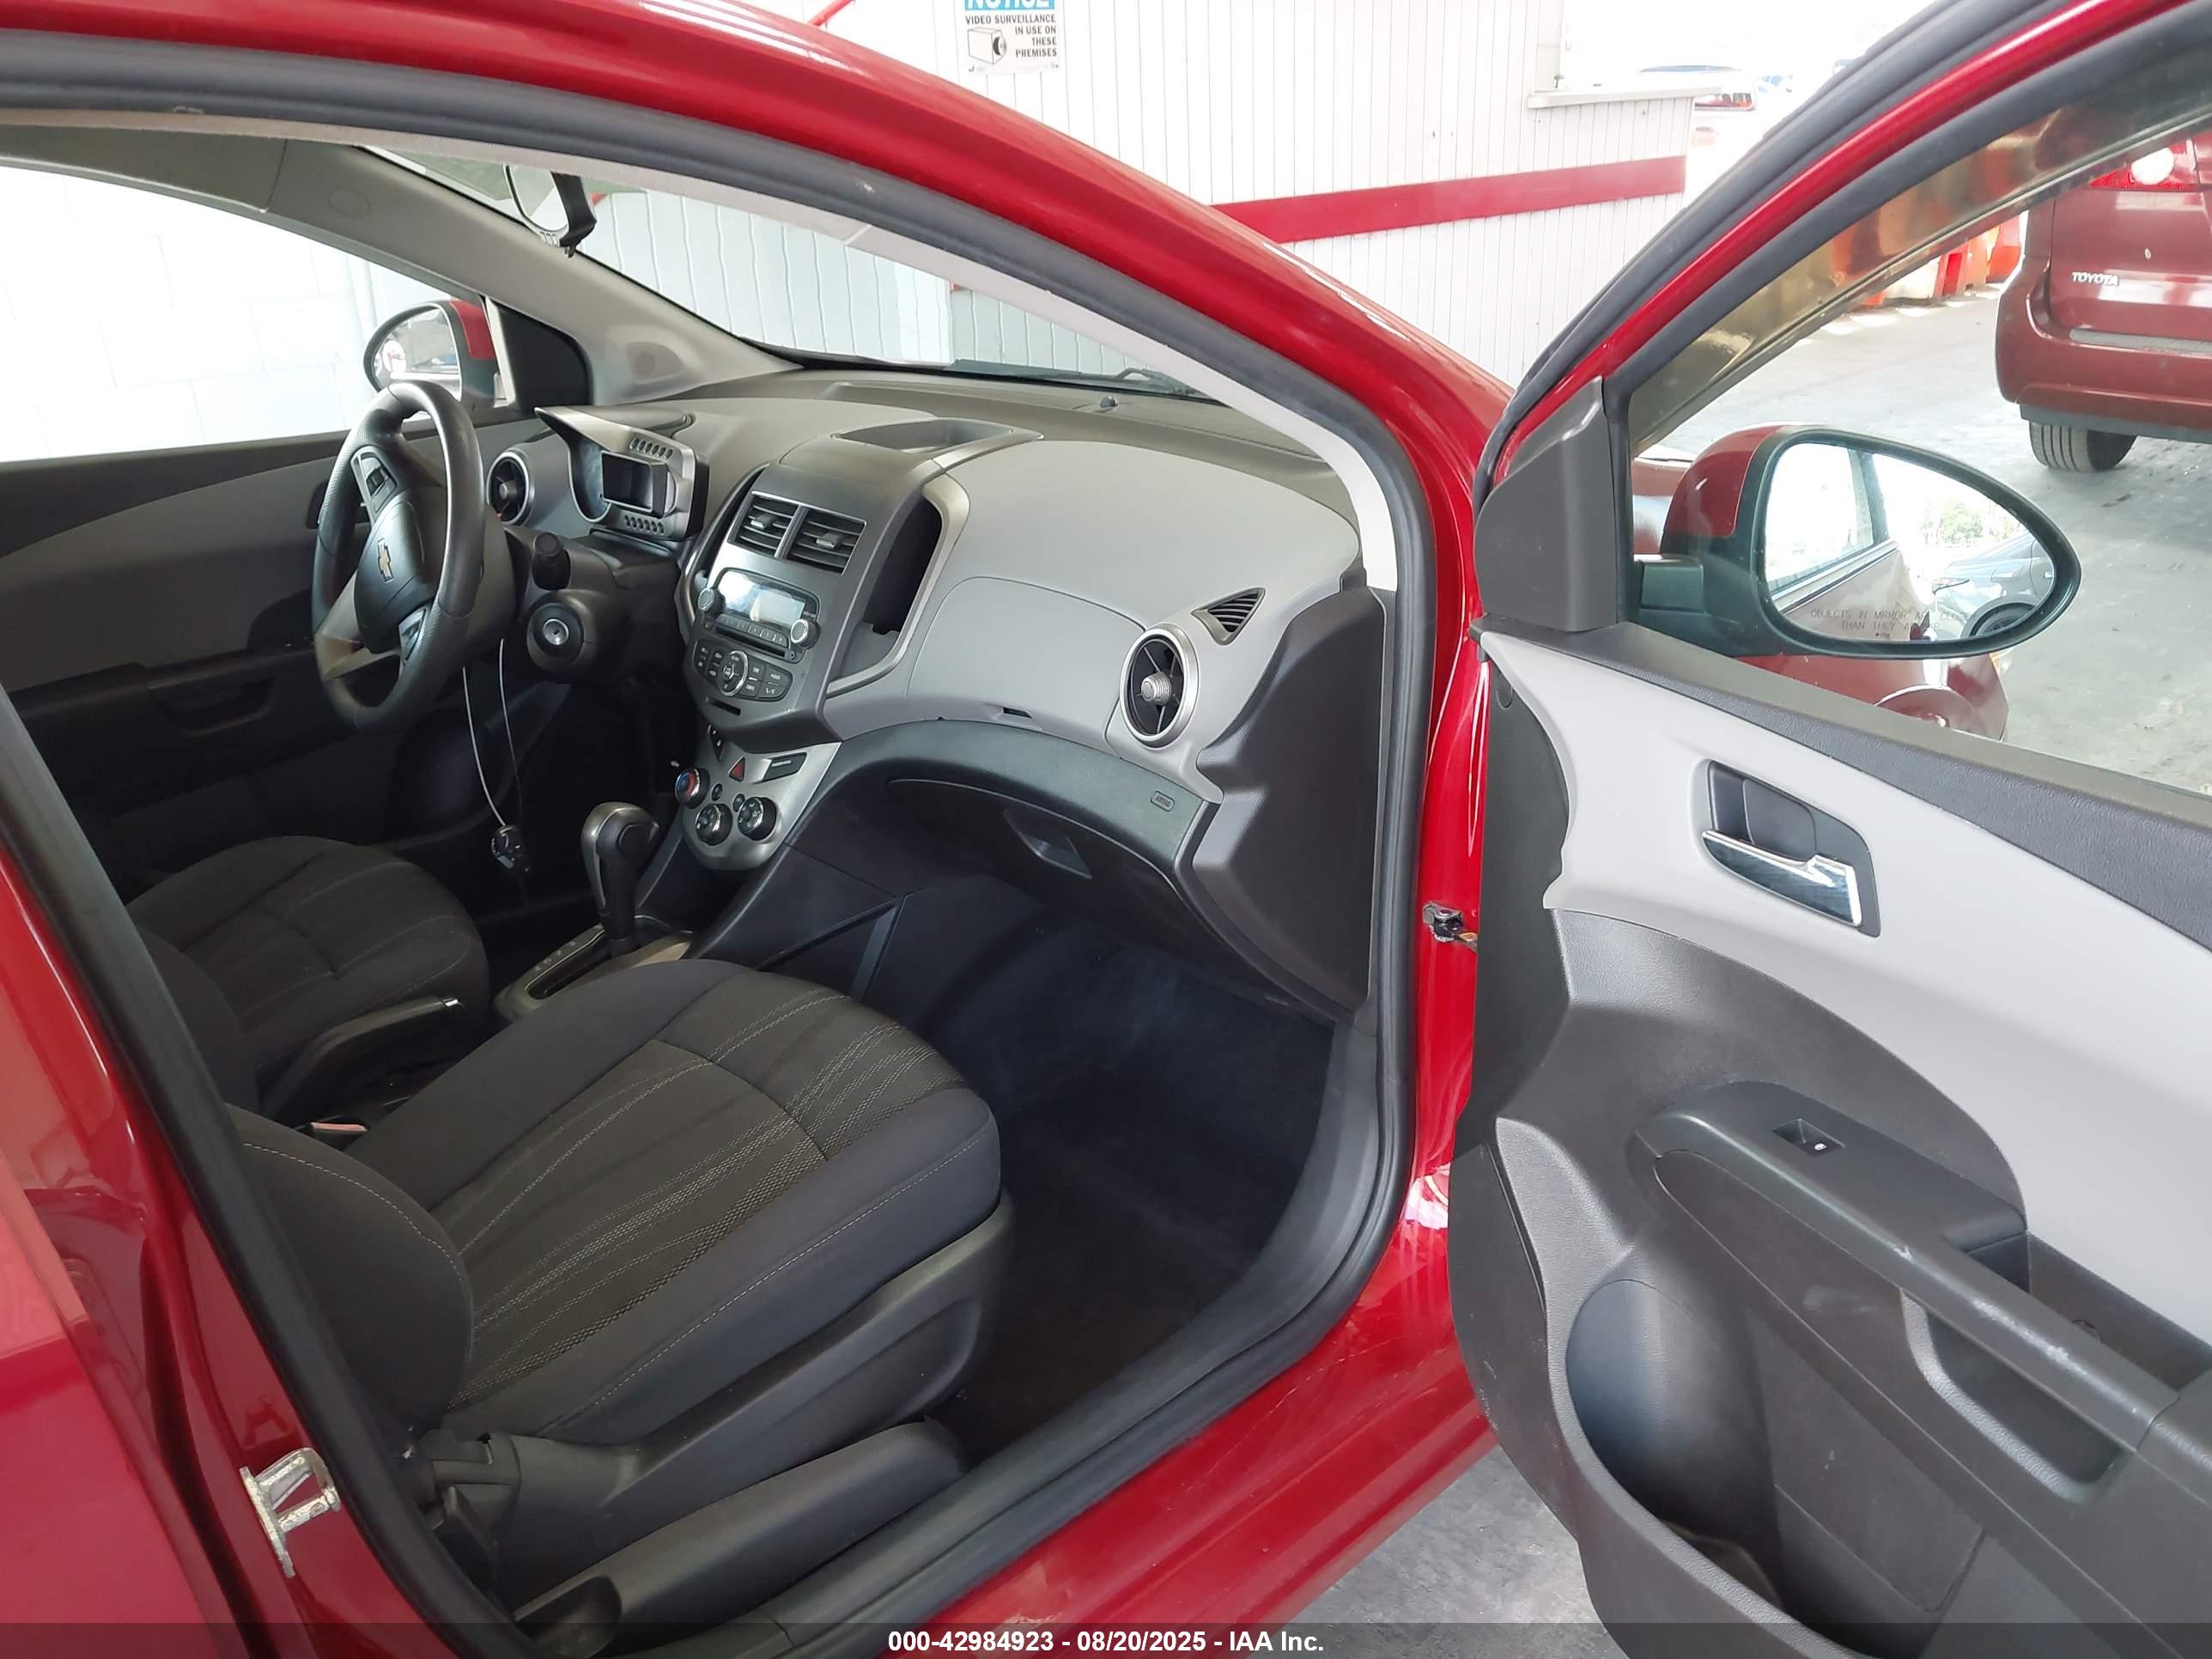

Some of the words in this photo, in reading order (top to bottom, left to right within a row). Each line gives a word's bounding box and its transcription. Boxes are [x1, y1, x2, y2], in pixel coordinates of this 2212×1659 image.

[965, 15, 992, 25] VIDEO
[994, 14, 1056, 24] SURVEILLANCE
[1015, 26, 1024, 34] IN
[1026, 25, 1042, 34] USE
[1045, 25, 1056, 34] ON
[1031, 36, 1057, 46] THESE
[1015, 47, 1058, 58] PREMISES
[2072, 271, 2118, 286] TOYOTA
